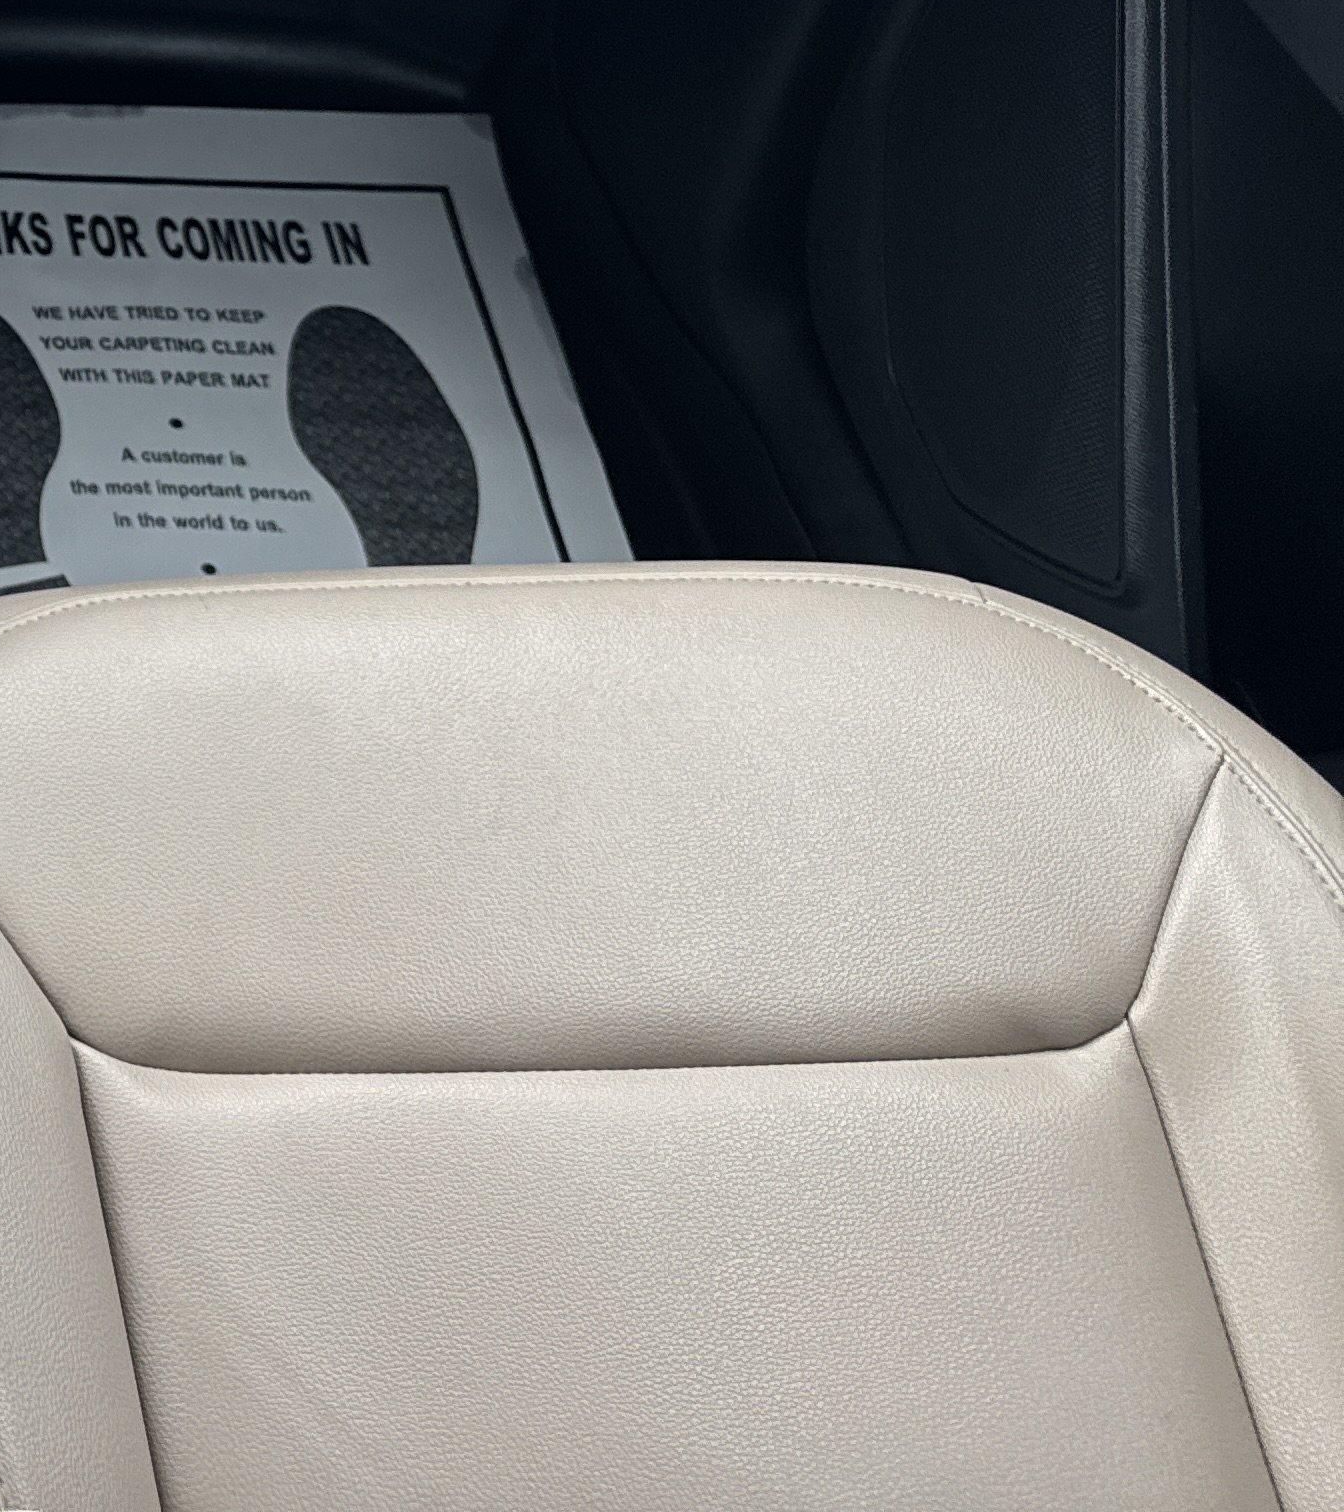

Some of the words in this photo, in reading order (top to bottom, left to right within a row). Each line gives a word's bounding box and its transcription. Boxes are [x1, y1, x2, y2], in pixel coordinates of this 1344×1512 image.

[64, 213, 148, 258] FOR
[156, 217, 313, 265] COMING
[322, 220, 371, 266] IN
[32, 306, 63, 320] WE
[69, 305, 119, 321] HAVE
[123, 306, 178, 322] TRIED
[184, 307, 211, 323] TO
[216, 308, 265, 324] KEEP
[39, 336, 93, 351] YOUR
[99, 336, 206, 354] CARPETING
[212, 339, 275, 356] CLEAN
[59, 367, 107, 383] WITH
[115, 368, 155, 384] THIS
[161, 371, 226, 388] PAPER
[231, 372, 270, 389] MAT
[121, 447, 137, 462] A
[141, 449, 224, 466] customer
[230, 451, 247, 466] is
[70, 480, 99, 495] the
[105, 481, 152, 496] most
[156, 480, 245, 501] important
[248, 487, 311, 503] person
[113, 512, 132, 527] in
[137, 512, 166, 528] the
[172, 514, 223, 530] world
[230, 516, 249, 531] to
[255, 519, 284, 533] us.
